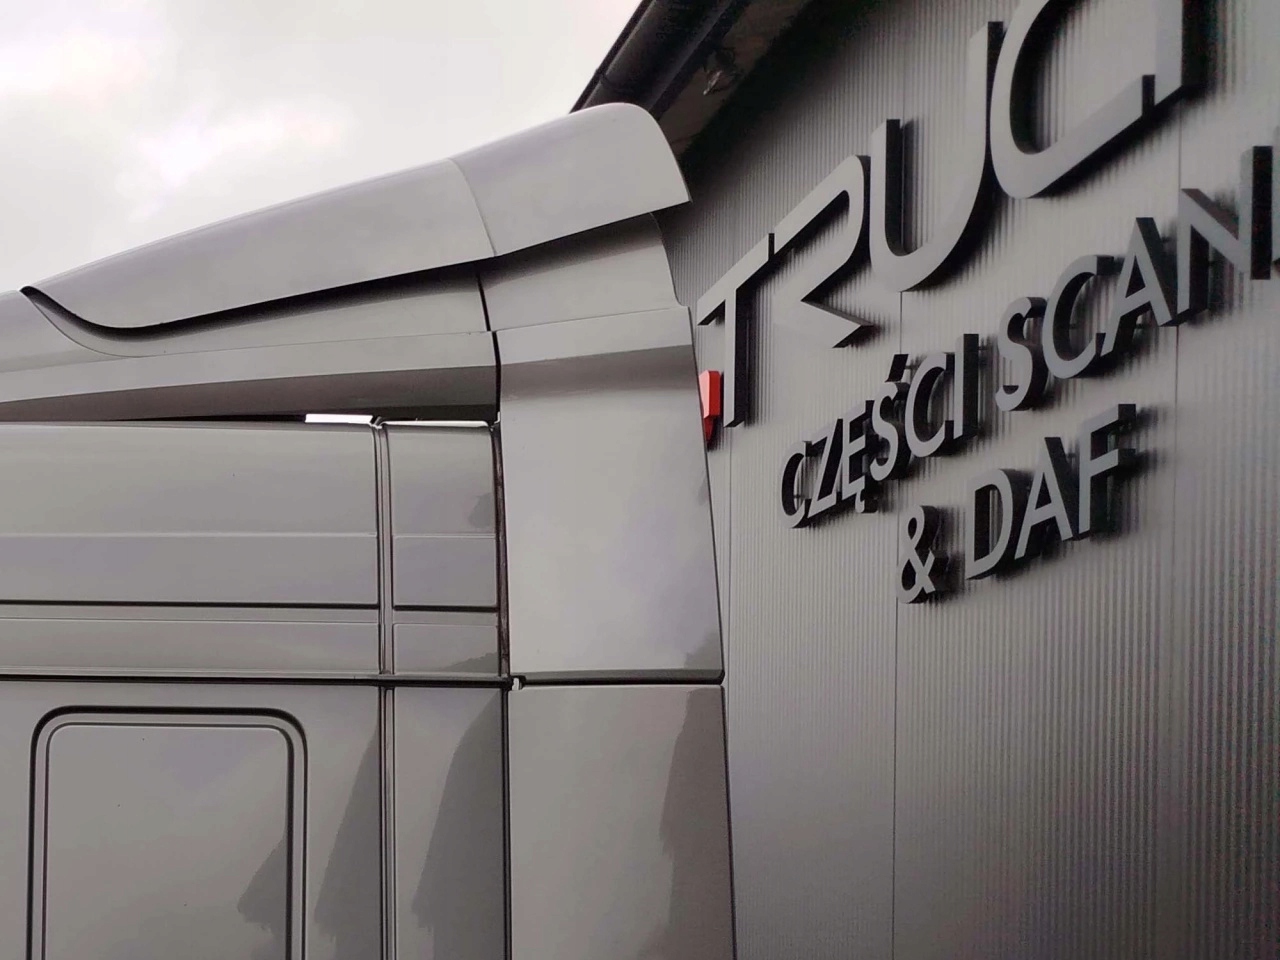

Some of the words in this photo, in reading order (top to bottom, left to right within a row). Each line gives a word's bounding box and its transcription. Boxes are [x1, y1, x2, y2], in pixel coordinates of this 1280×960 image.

[780, 333, 978, 528] CZĘŚCI
[896, 504, 940, 604] &
[964, 403, 1136, 580] DAF
